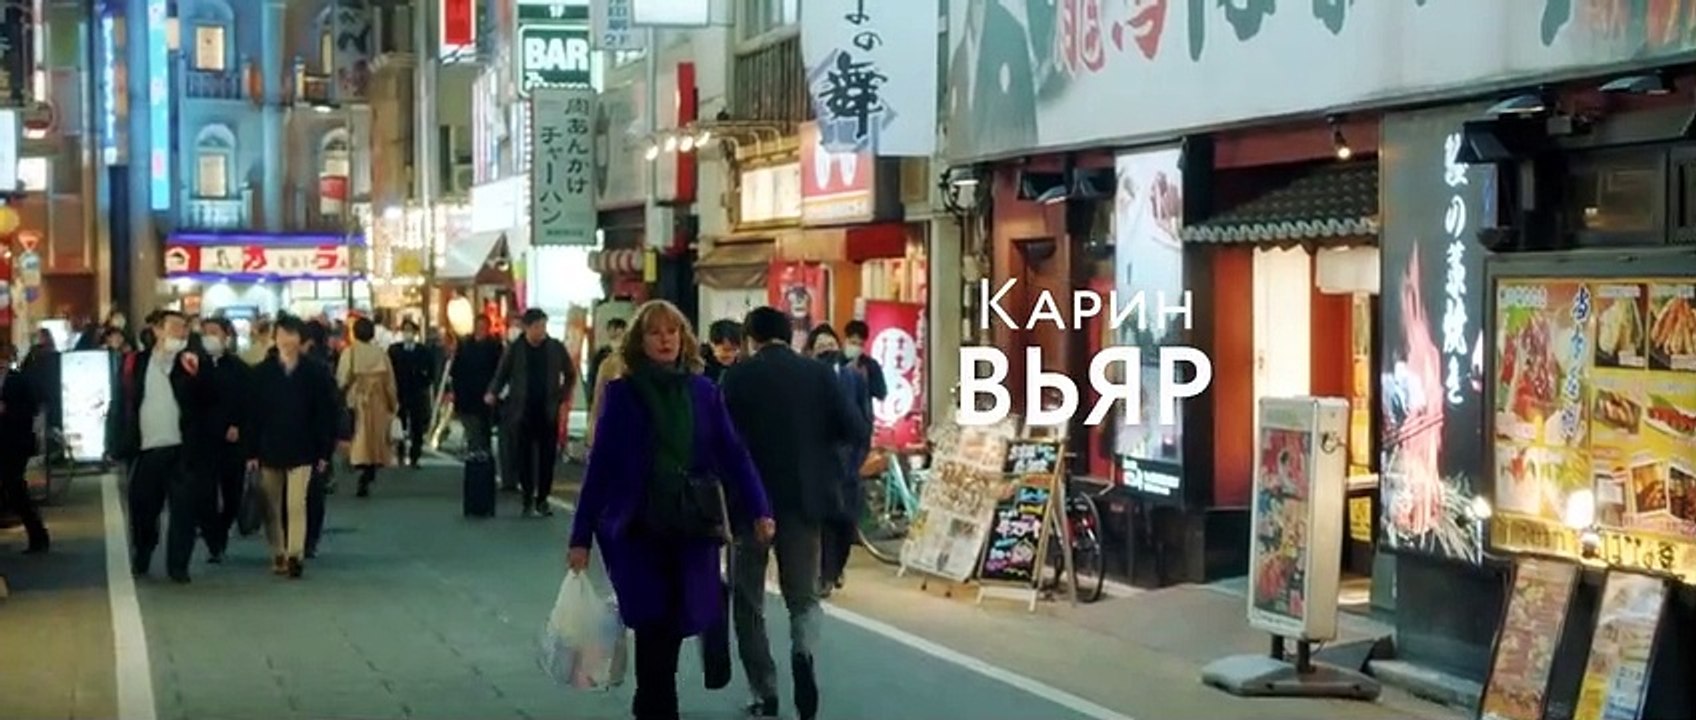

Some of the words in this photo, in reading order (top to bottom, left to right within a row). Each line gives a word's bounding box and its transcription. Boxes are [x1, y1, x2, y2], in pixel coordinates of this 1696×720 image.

[524, 37, 589, 71] BAR
[539, 126, 563, 225] チャーハン
